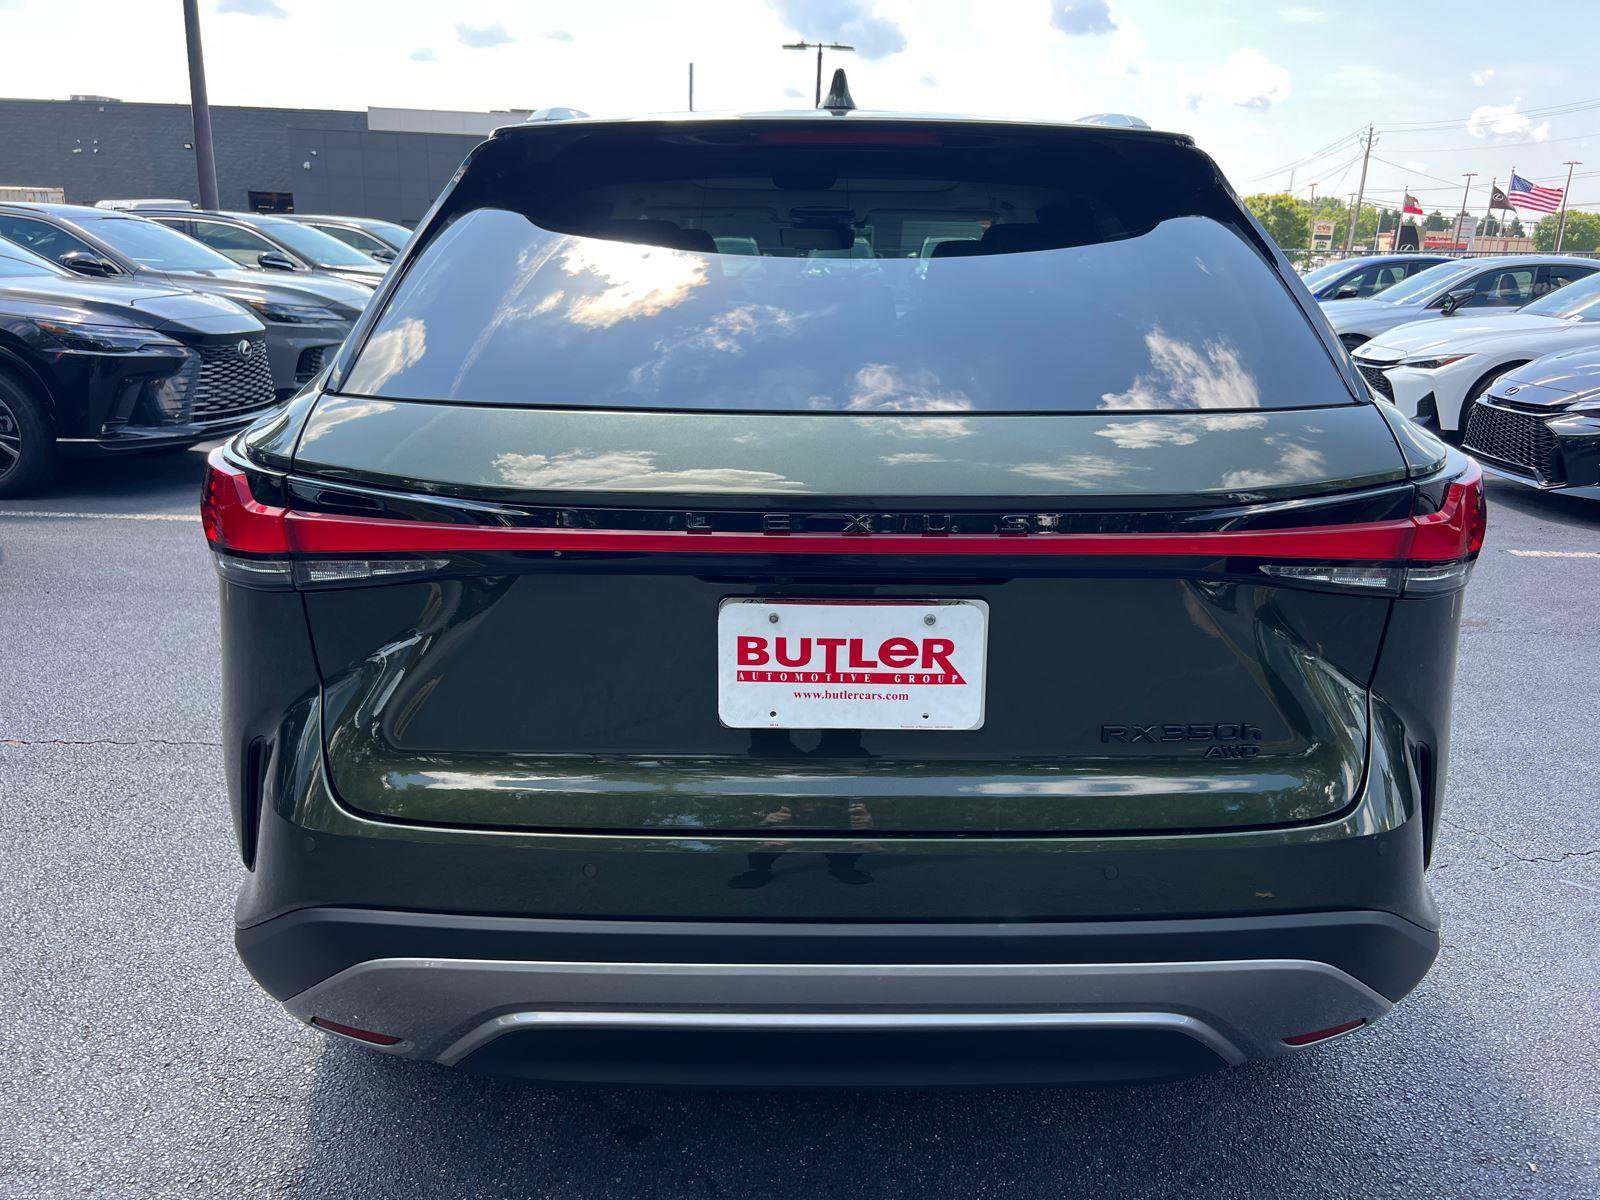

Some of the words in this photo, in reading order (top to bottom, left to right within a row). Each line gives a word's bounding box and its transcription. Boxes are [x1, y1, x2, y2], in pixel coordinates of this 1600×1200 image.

[685, 512, 1029, 535] LEXUS
[738, 672, 872, 684] AUTOMOTIVE
[894, 674, 960, 684] GROUP
[793, 689, 910, 702] www.butlercars.com
[1204, 744, 1261, 759] AWD
